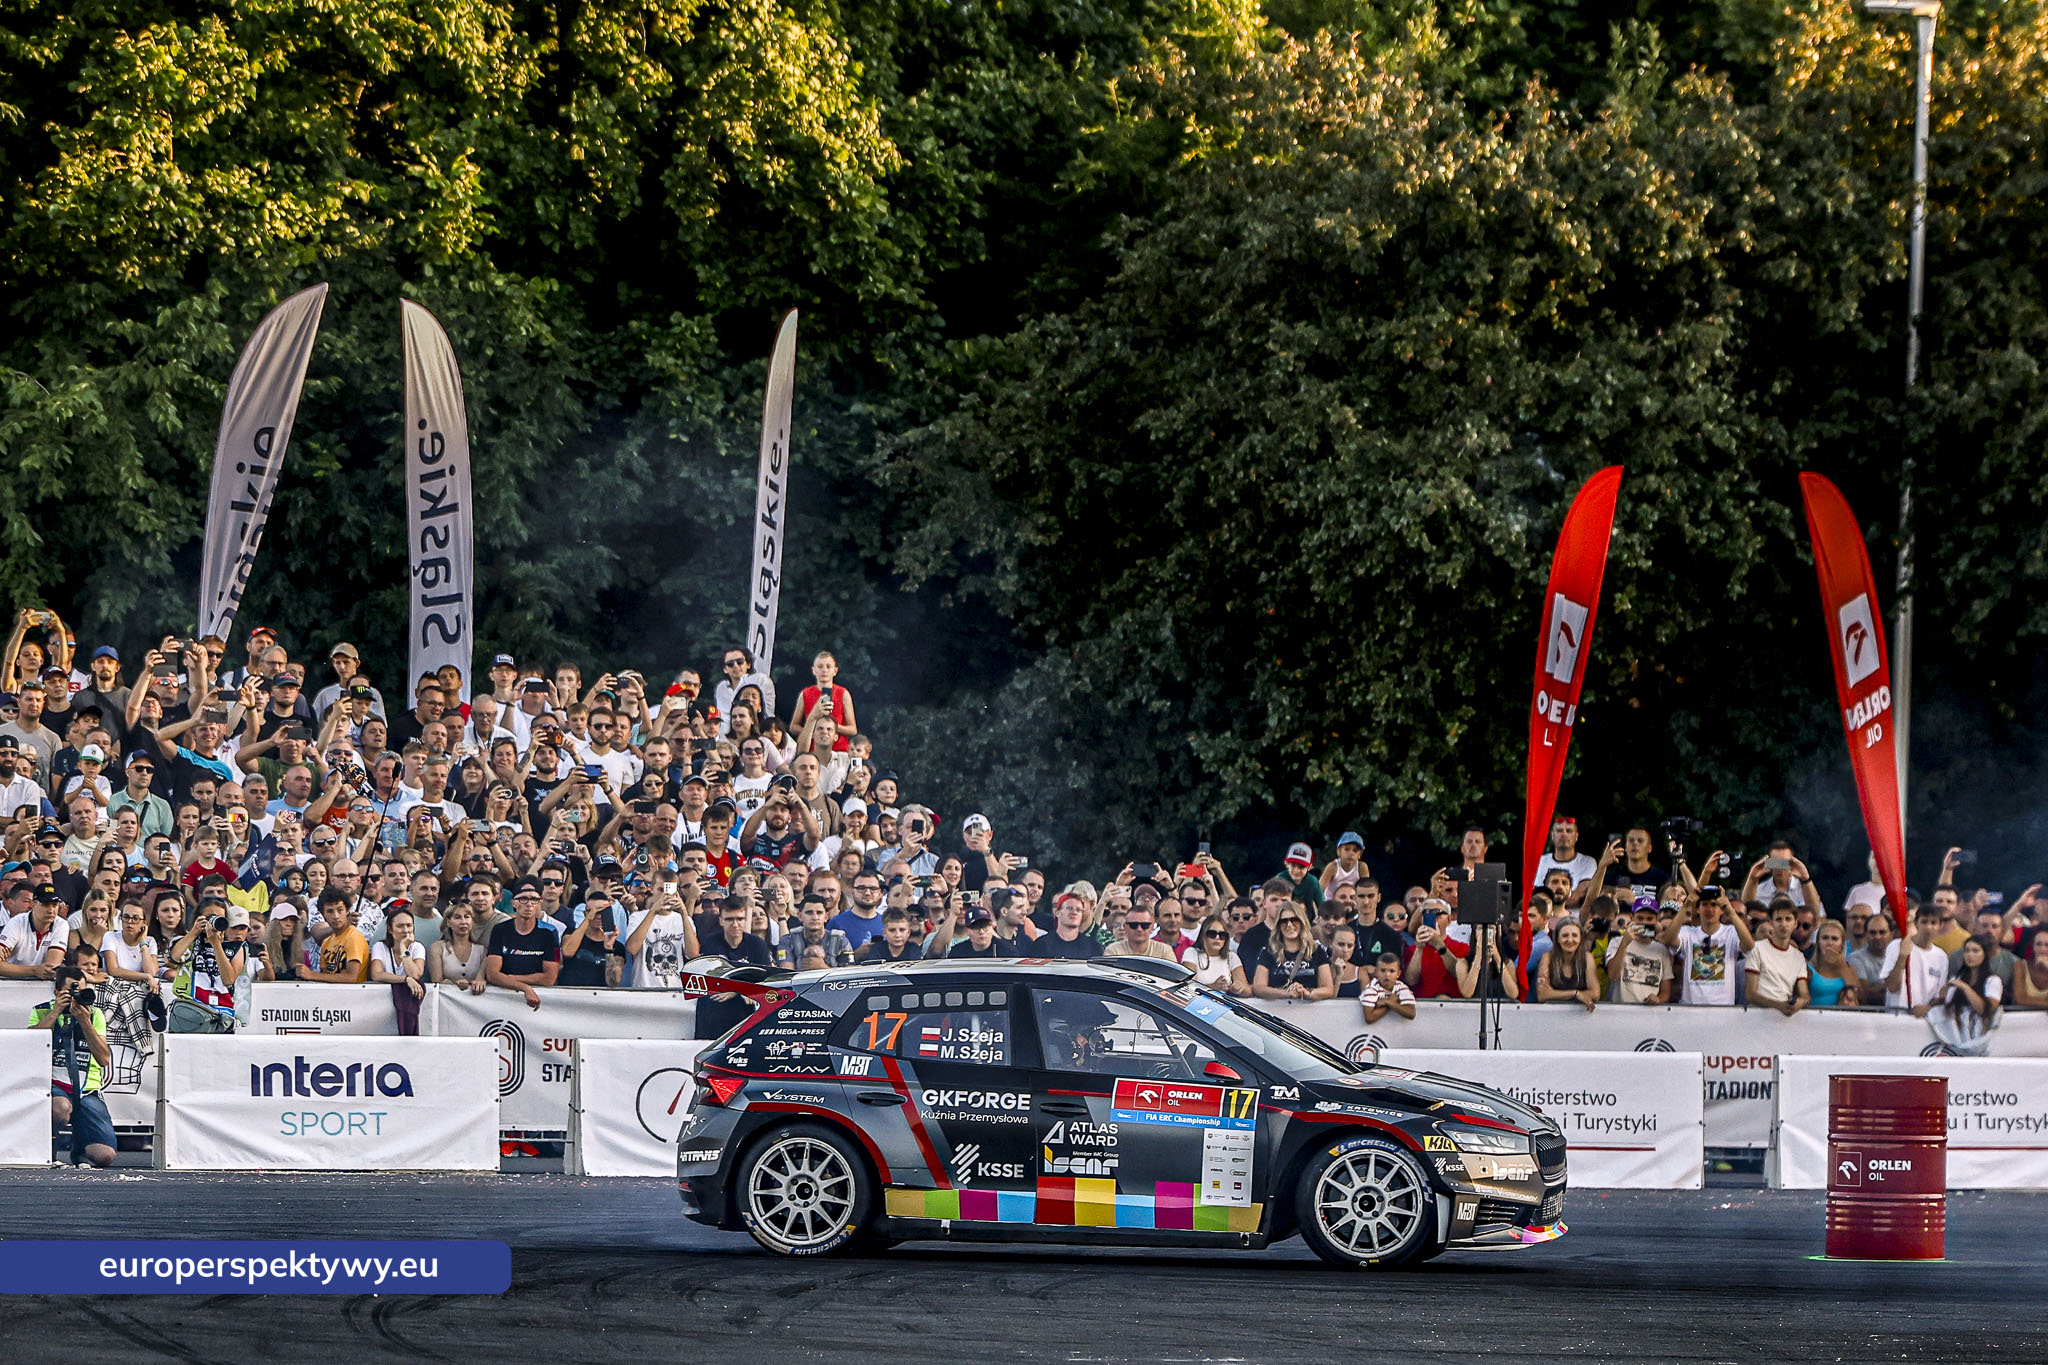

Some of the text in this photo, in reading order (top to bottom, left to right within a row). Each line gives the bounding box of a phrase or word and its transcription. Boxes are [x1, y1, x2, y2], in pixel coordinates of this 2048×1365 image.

[261, 1006, 352, 1026] STADION ŚLĄSKI
[794, 1010, 834, 1018] STASIAK
[863, 1011, 908, 1050] 17
[942, 1028, 1004, 1045] J.Szeja
[728, 1056, 749, 1064] Fuks
[940, 1045, 1004, 1064] M.Szeja
[251, 1056, 414, 1097] interia
[921, 1089, 1031, 1111] GKFORGE
[1168, 1090, 1203, 1100] ORLEN
[1167, 1099, 1181, 1107] OIL
[1228, 1090, 1255, 1119] 17
[920, 1109, 1029, 1125] Kuźnia Przemysłowa
[1346, 1105, 1404, 1118] KATOWICE
[280, 1111, 388, 1136] SPORT
[1146, 1113, 1158, 1121] FIA
[1174, 1116, 1221, 1126] Championship
[1573, 1113, 1657, 1134] Turystyki
[1069, 1121, 1119, 1134] ATLAS
[1069, 1133, 1118, 1147] WARD
[1347, 1139, 1397, 1151] MICHELIN
[977, 1162, 1025, 1178] KSSE
[1868, 1160, 1912, 1171] ORLEN
[1868, 1172, 1885, 1181] OIL
